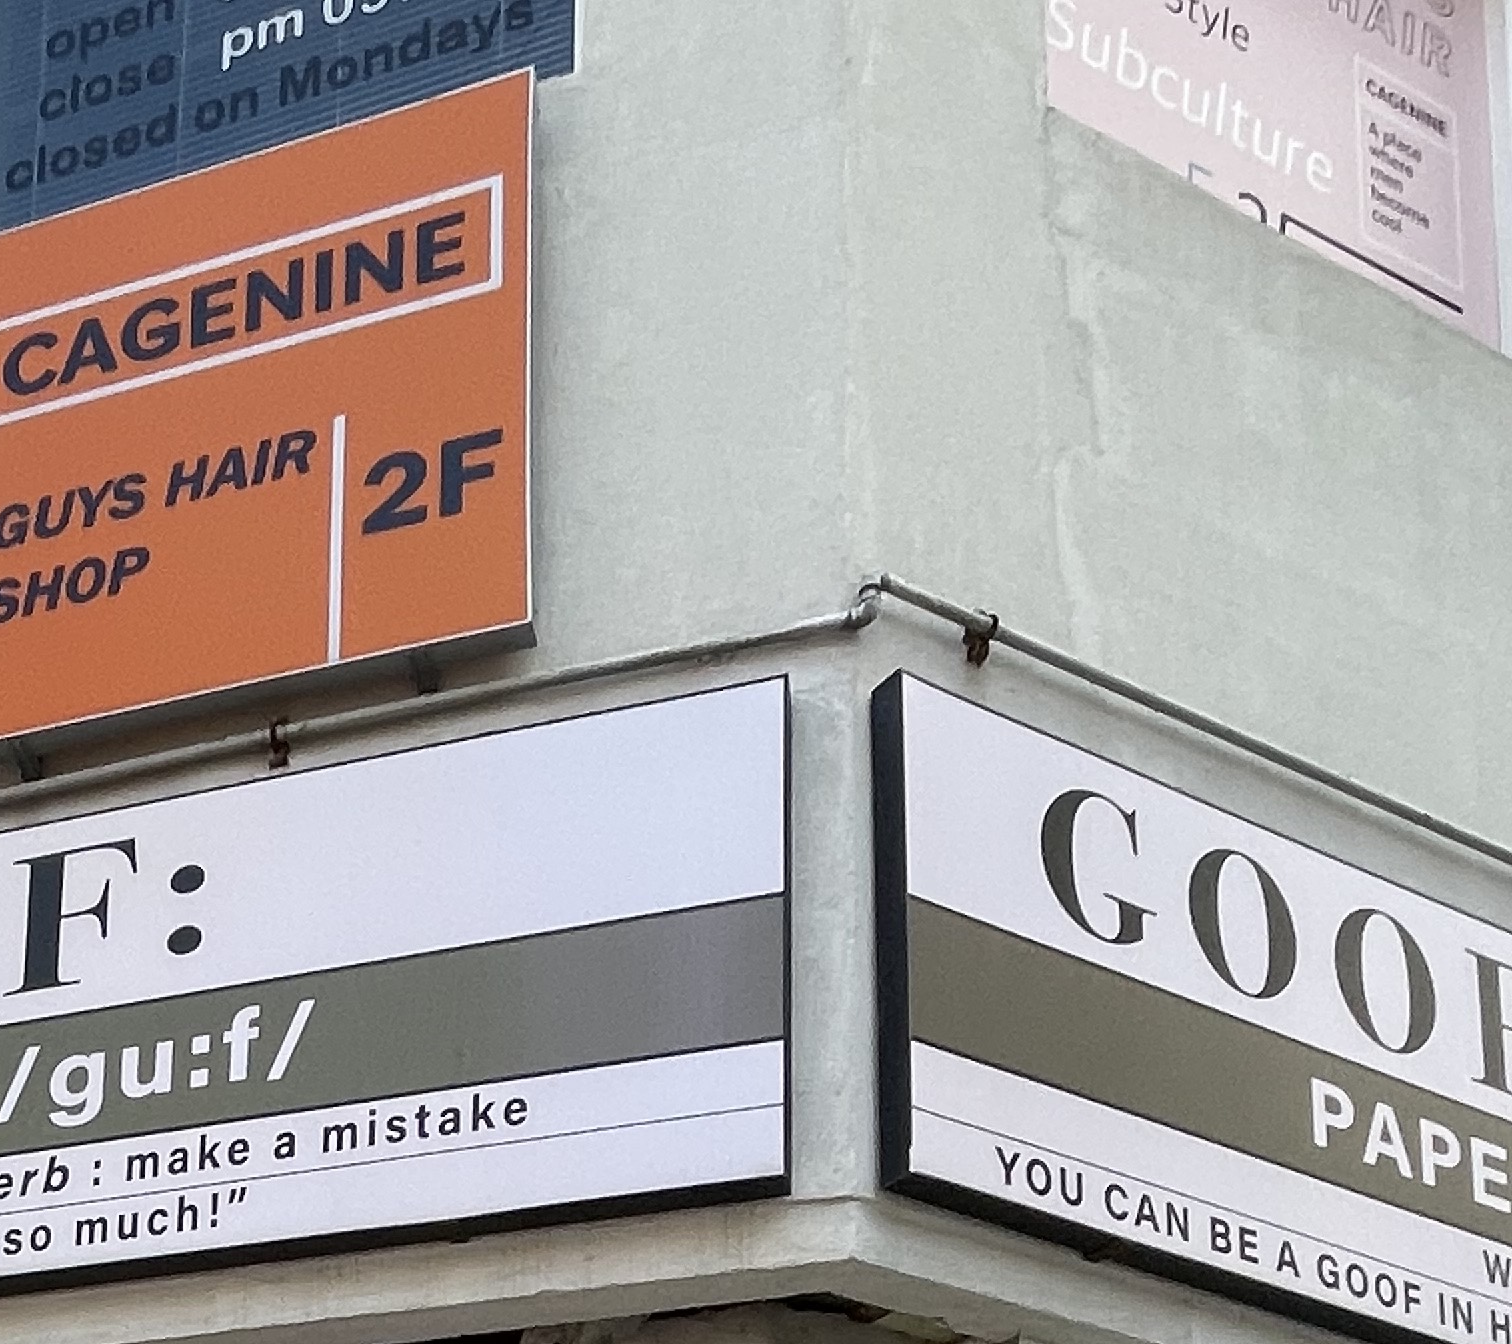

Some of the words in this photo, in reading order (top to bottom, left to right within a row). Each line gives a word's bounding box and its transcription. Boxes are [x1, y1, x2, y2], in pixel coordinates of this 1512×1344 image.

[5, 106, 178, 192] closed
[195, 86, 258, 133] on
[278, 2, 535, 108] Mondays
[39, 50, 177, 121] close
[220, 8, 304, 71] pm
[1046, 0, 1334, 193] Subculture
[1, 211, 467, 397] CAGENINE
[165, 430, 317, 508] HAIR
[361, 428, 504, 535] 2F
[125, 1133, 251, 1182] make
[273, 1130, 297, 1160] a
[322, 1093, 529, 1154] mistake
[1309, 1075, 1512, 1214] PAPE
[2, 1223, 53, 1256] so
[994, 1145, 1083, 1207] YOU
[1103, 1183, 1191, 1243] CAN
[1209, 1215, 1262, 1265] BE
[1276, 1239, 1302, 1279] A
[1316, 1253, 1422, 1315] GOOF
[1438, 1292, 1475, 1335] IN
